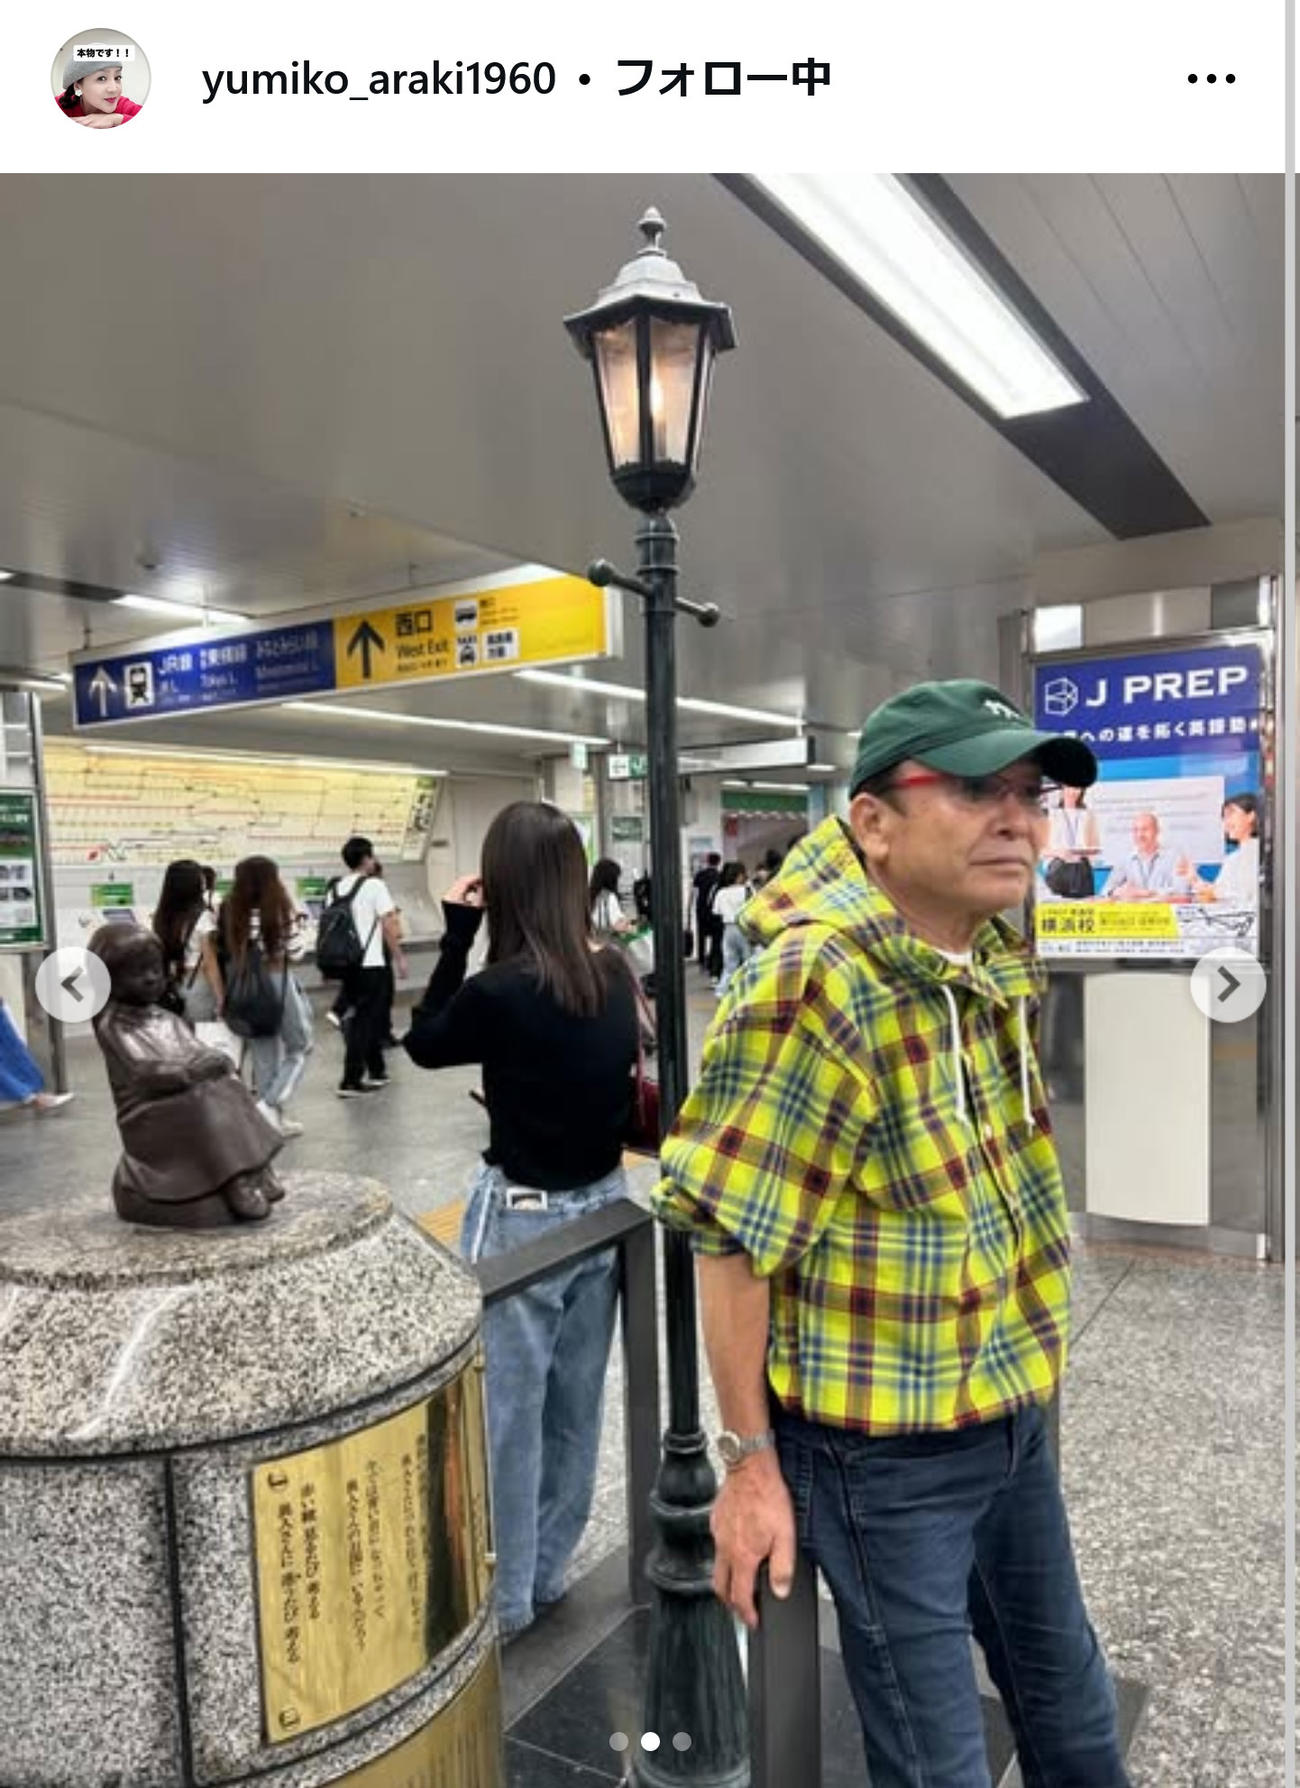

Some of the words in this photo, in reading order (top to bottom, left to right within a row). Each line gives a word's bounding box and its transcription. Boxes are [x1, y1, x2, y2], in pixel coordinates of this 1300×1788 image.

[395, 610, 432, 636] 西口
[1086, 679, 1107, 707] J
[1123, 665, 1247, 705] PREP
